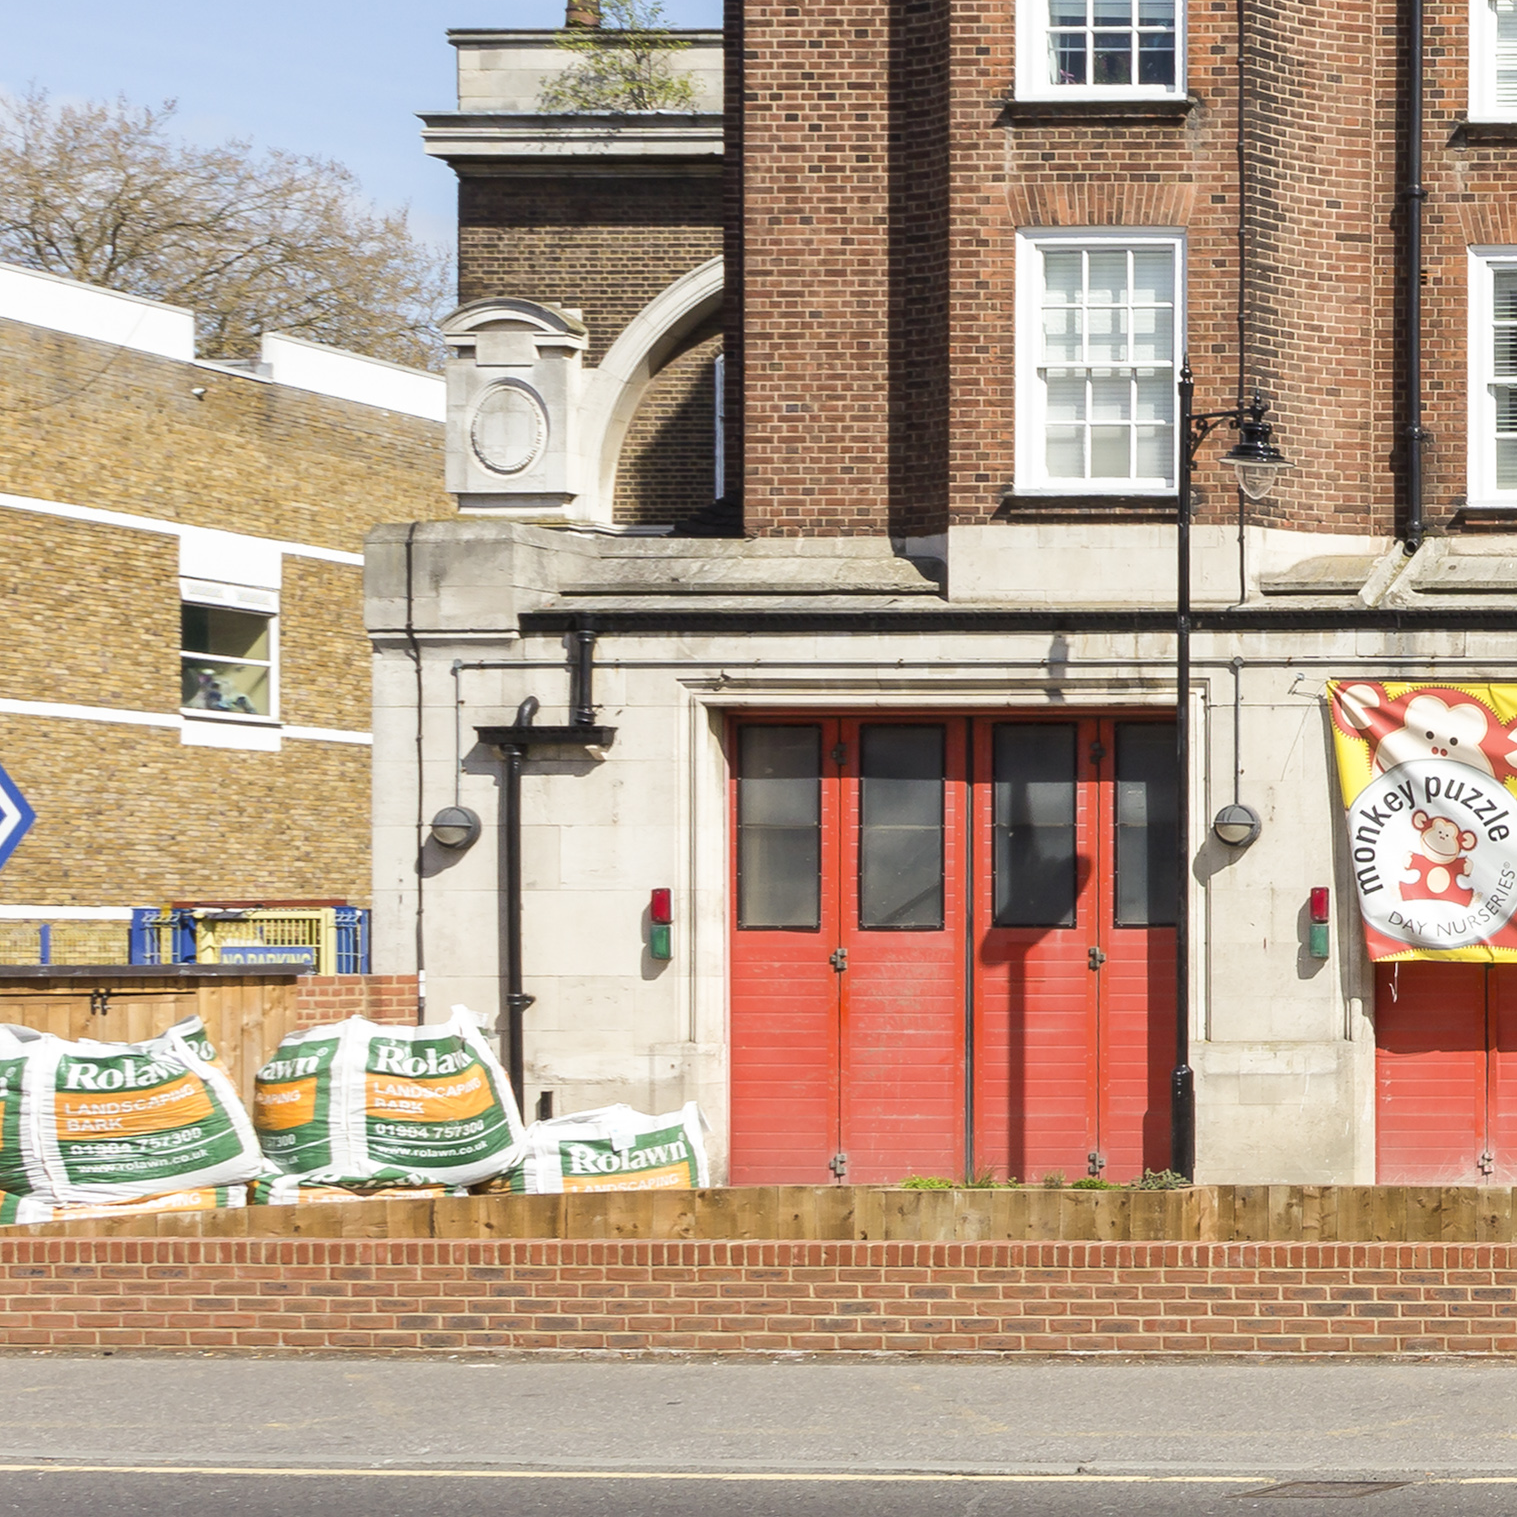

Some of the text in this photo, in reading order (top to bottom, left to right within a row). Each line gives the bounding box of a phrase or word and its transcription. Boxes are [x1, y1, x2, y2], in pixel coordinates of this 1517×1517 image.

[1354, 776, 1510, 896] monkey puzzle
[1388, 910, 1428, 936] DAY
[65, 1084, 195, 1116] LANDSCAPING
[374, 1077, 482, 1099] LANDSCAPING
[374, 1097, 425, 1114] BARK
[66, 1117, 123, 1132] BARK
[432, 1119, 484, 1139] 757300
[135, 1127, 202, 1151] 757300
[375, 1140, 488, 1158] www.rolawn.co.uk
[76, 1149, 209, 1173] www.rolawn.co.uk
[566, 1139, 689, 1174] Rolawn
